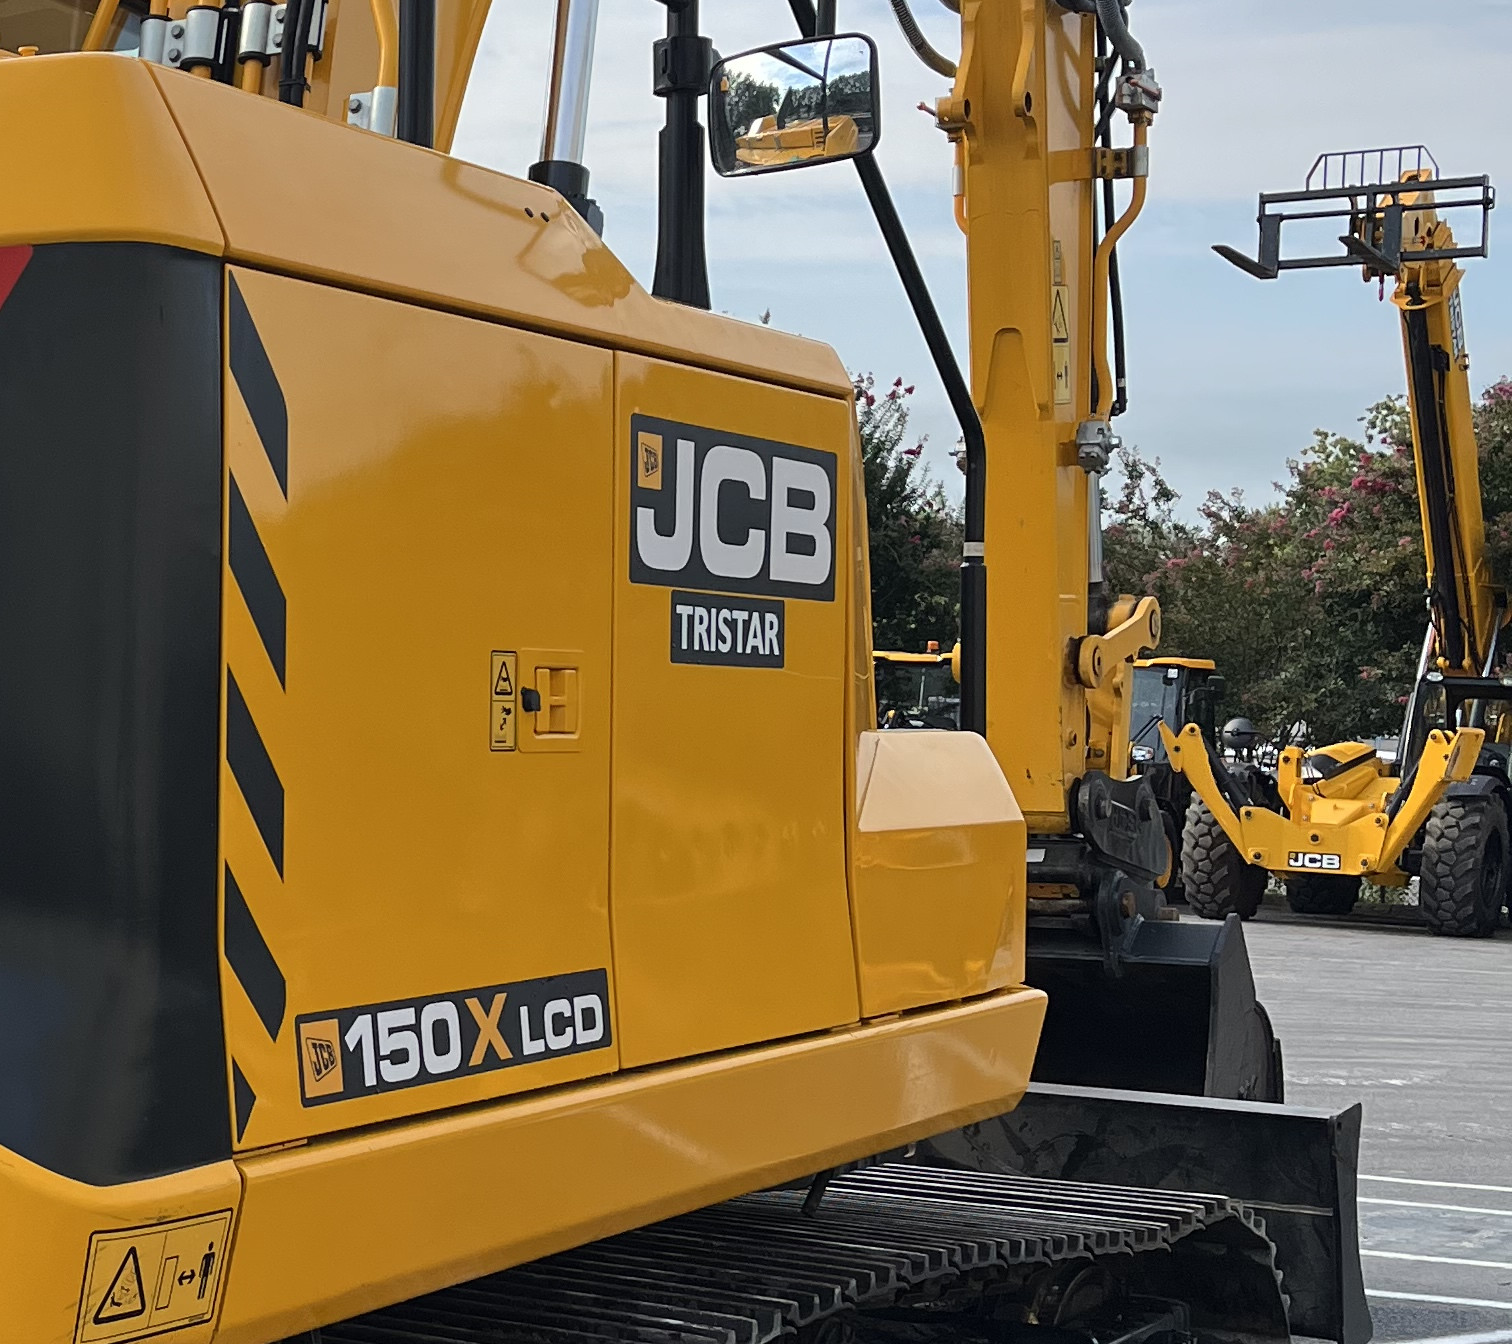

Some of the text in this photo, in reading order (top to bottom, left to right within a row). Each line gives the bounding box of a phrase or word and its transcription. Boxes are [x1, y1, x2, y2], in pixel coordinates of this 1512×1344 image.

[637, 438, 832, 585] JCB
[676, 604, 780, 656] TRISTAR
[1288, 852, 1340, 869] JCB
[519, 993, 605, 1056] LCD
[311, 1042, 334, 1076] JCB
